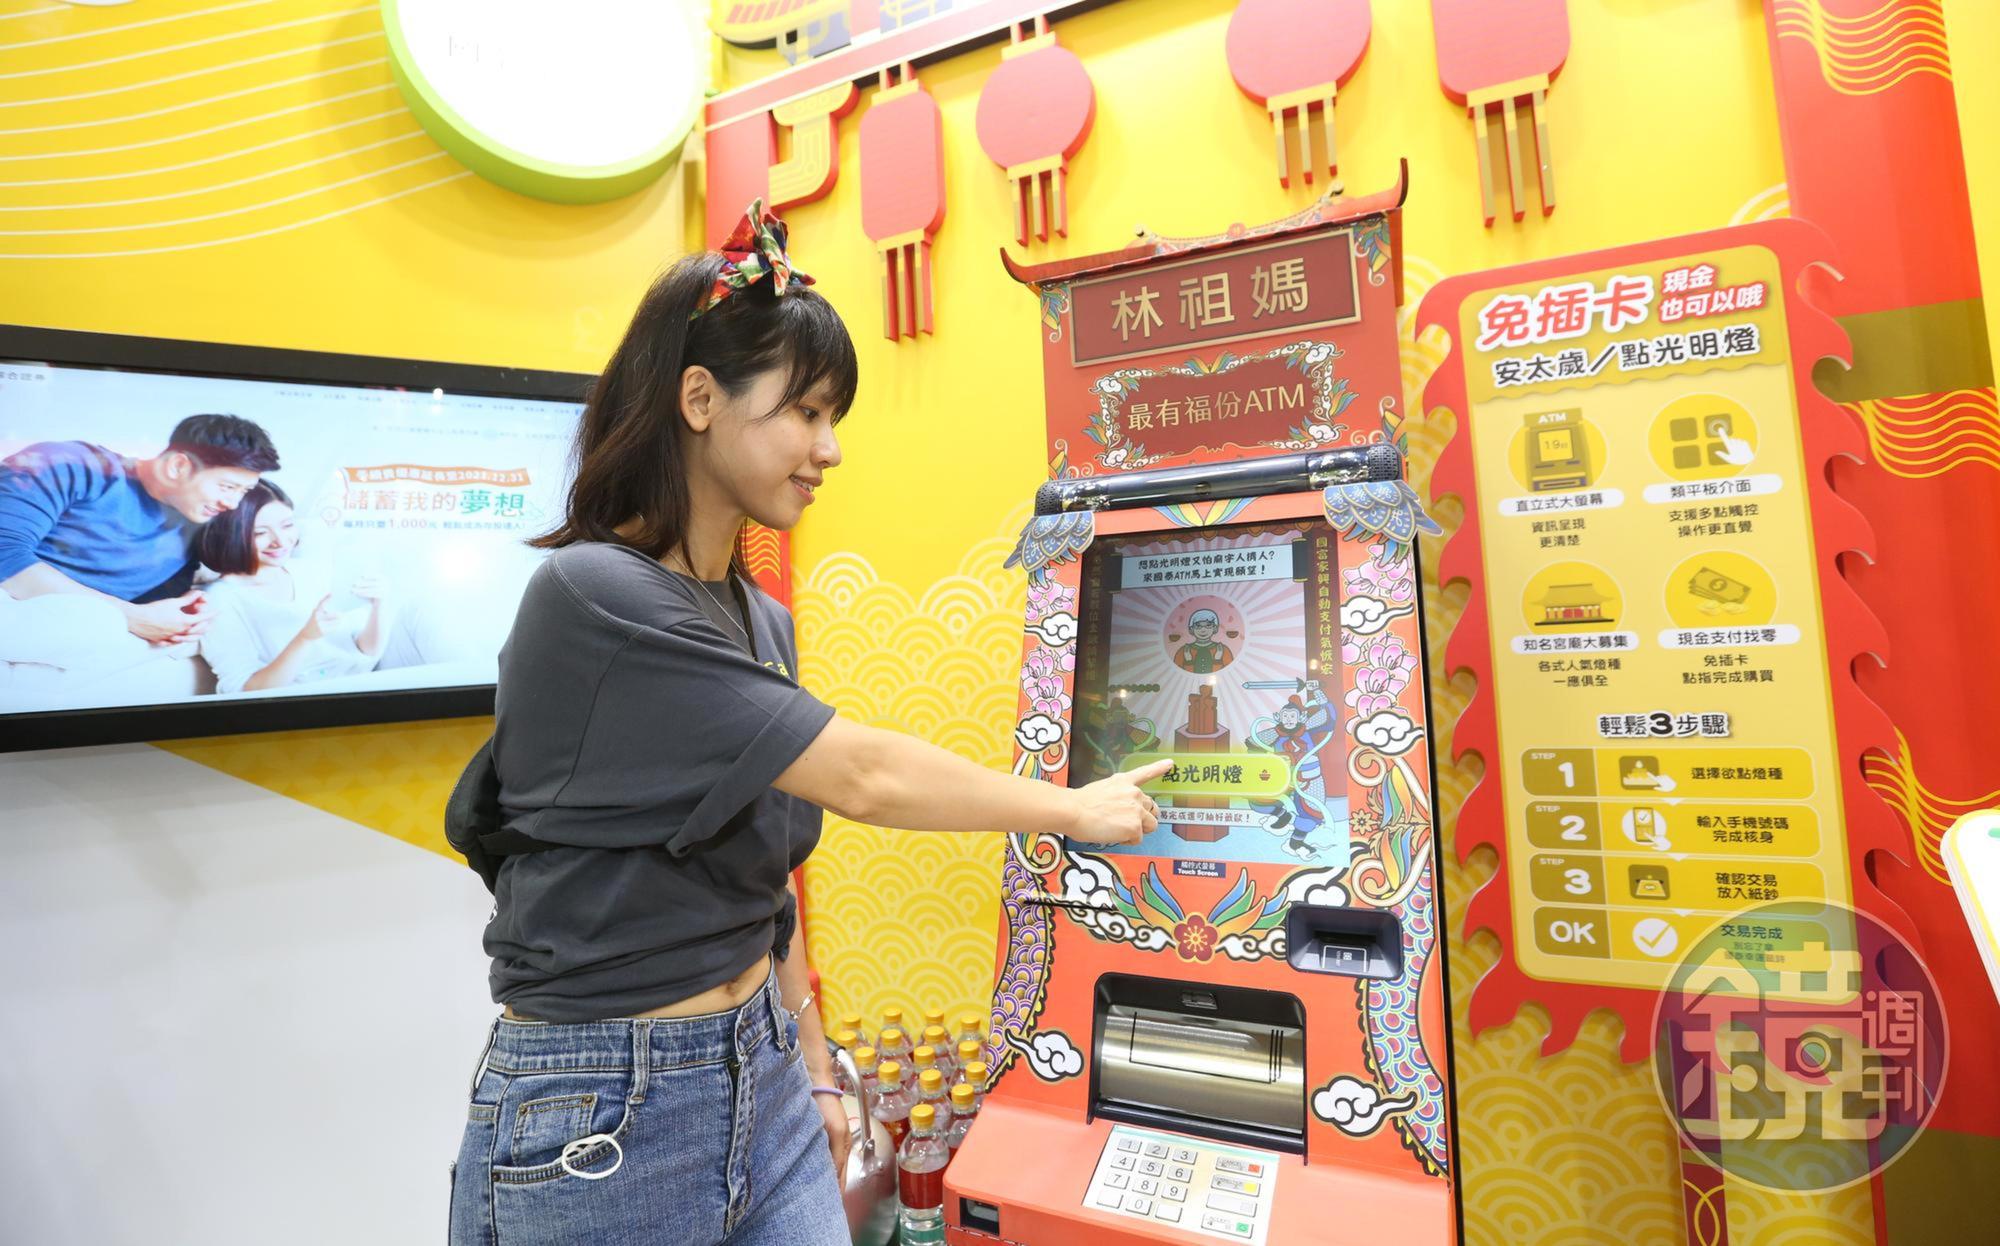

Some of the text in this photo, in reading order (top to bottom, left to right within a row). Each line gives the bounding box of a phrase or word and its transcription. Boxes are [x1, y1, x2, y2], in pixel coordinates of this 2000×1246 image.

[1662, 264, 1714, 294] 現金
[1110, 257, 1309, 342] 林祖媽
[1658, 283, 1765, 322] 也可以哦
[1480, 279, 1650, 348] 免插卡
[1127, 383, 1306, 431] 最有福份ATM
[1538, 412, 1567, 424] ATM
[1670, 479, 1751, 499] 類平板介面
[343, 489, 525, 517] 儲蓄我的夢想
[1515, 493, 1604, 513] 直立式大螢幕
[1668, 503, 1760, 523] 支援多點觸控
[1531, 517, 1586, 534] 資訊呈現
[1677, 520, 1753, 538] 操作更直覺
[1540, 535, 1581, 549] 更清楚
[1523, 634, 1629, 652] 知名宮廟大募集
[1678, 629, 1777, 646] 現金支付找零
[1538, 657, 1622, 672] 各式人氣燈種
[1703, 654, 1749, 667] 免插卡
[1553, 674, 1609, 687] 一應俱全
[1682, 669, 1775, 685] 點指完成購買
[1599, 712, 1727, 736] 輕鬆3步驟
[1530, 752, 1557, 760] STEP
[1162, 763, 1244, 785] 點光明燈
[1557, 761, 1576, 788] 1
[1691, 767, 1783, 781] 選擇欲點燈種
[1535, 804, 1561, 813] STEP
[1559, 815, 1588, 841] 2
[1696, 815, 1789, 831] 輸入手機號碼
[1713, 831, 1774, 844] 完成核身
[1539, 858, 1565, 866] STEP
[1197, 869, 1219, 877] Screen
[1563, 868, 1593, 895] 3
[1714, 872, 1779, 888] 確認交易
[1716, 887, 1779, 901] 放入紙鈔
[1549, 920, 1597, 946] OK
[1720, 924, 1784, 940] 交易完成
[1126, 1140, 1189, 1160] 1 2 3
[1118, 1157, 1183, 1178] 4 5 6
[1113, 1174, 1178, 1196] 7 8 9
[1134, 1199, 1143, 1209] 0
